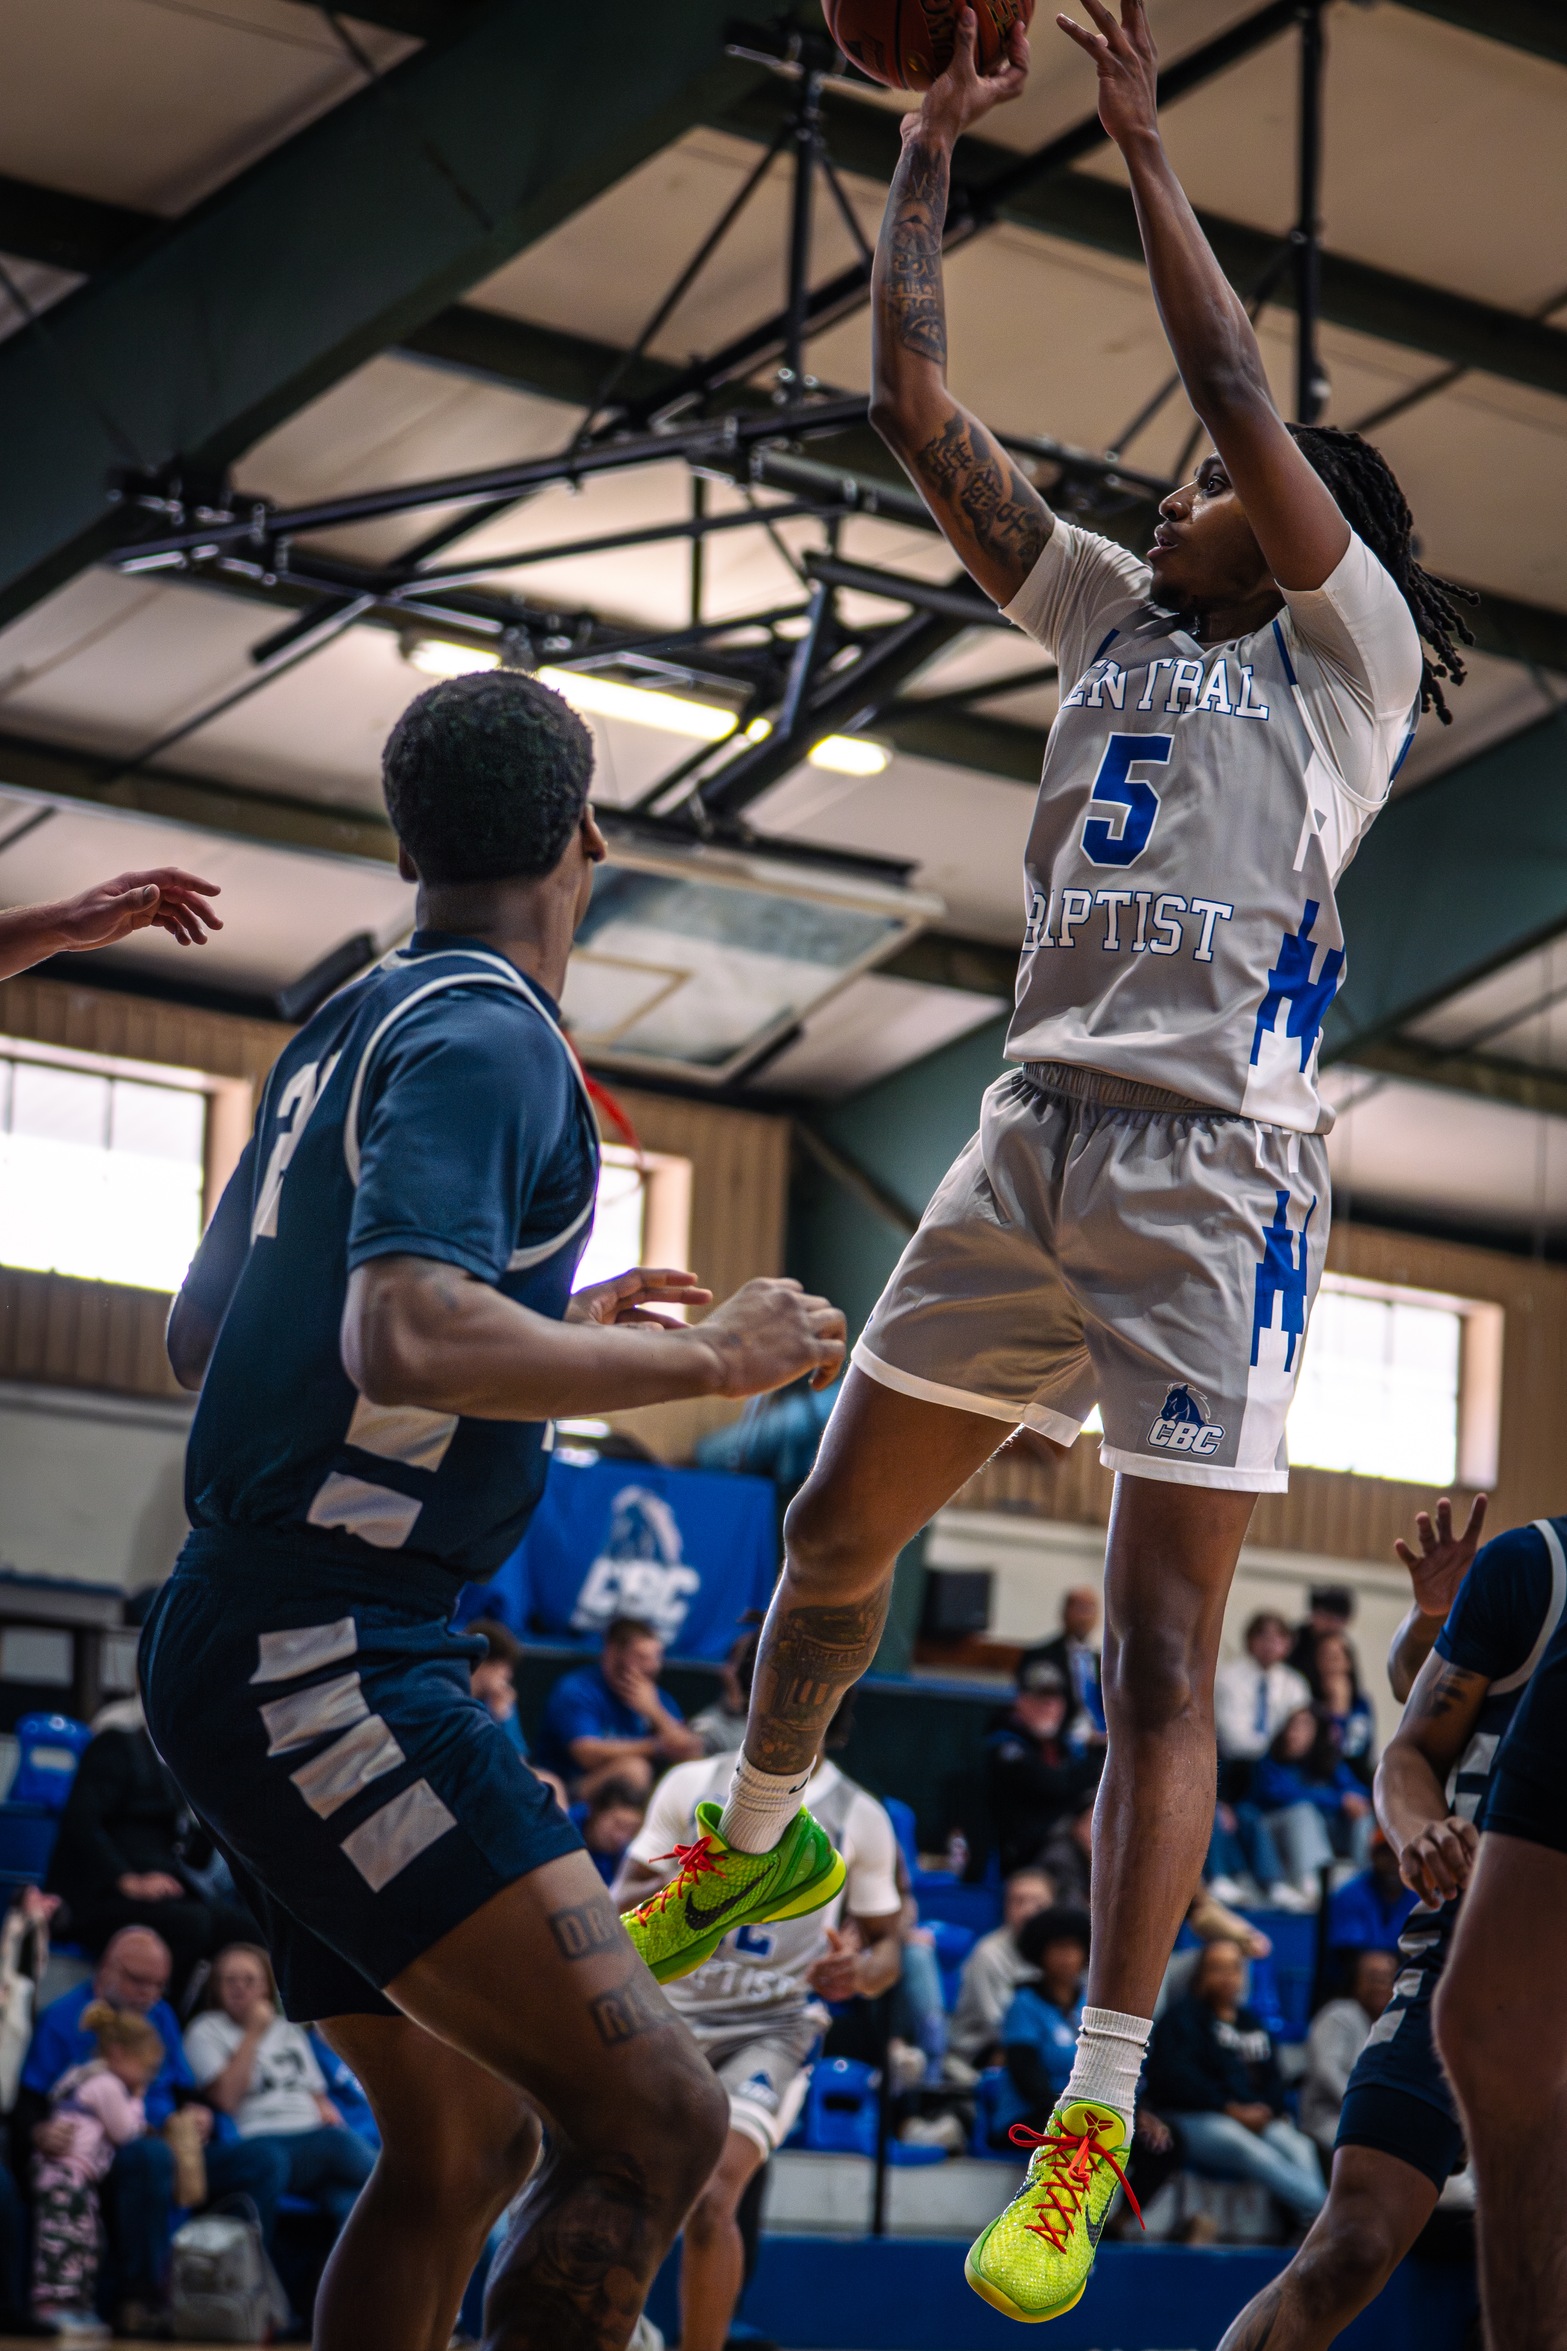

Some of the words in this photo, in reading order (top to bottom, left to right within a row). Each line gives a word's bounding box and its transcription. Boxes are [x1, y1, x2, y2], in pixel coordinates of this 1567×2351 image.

[1059, 657, 1269, 721] ENTRAL
[1080, 731, 1175, 869] 5
[1146, 1415, 1226, 1456] CBC
